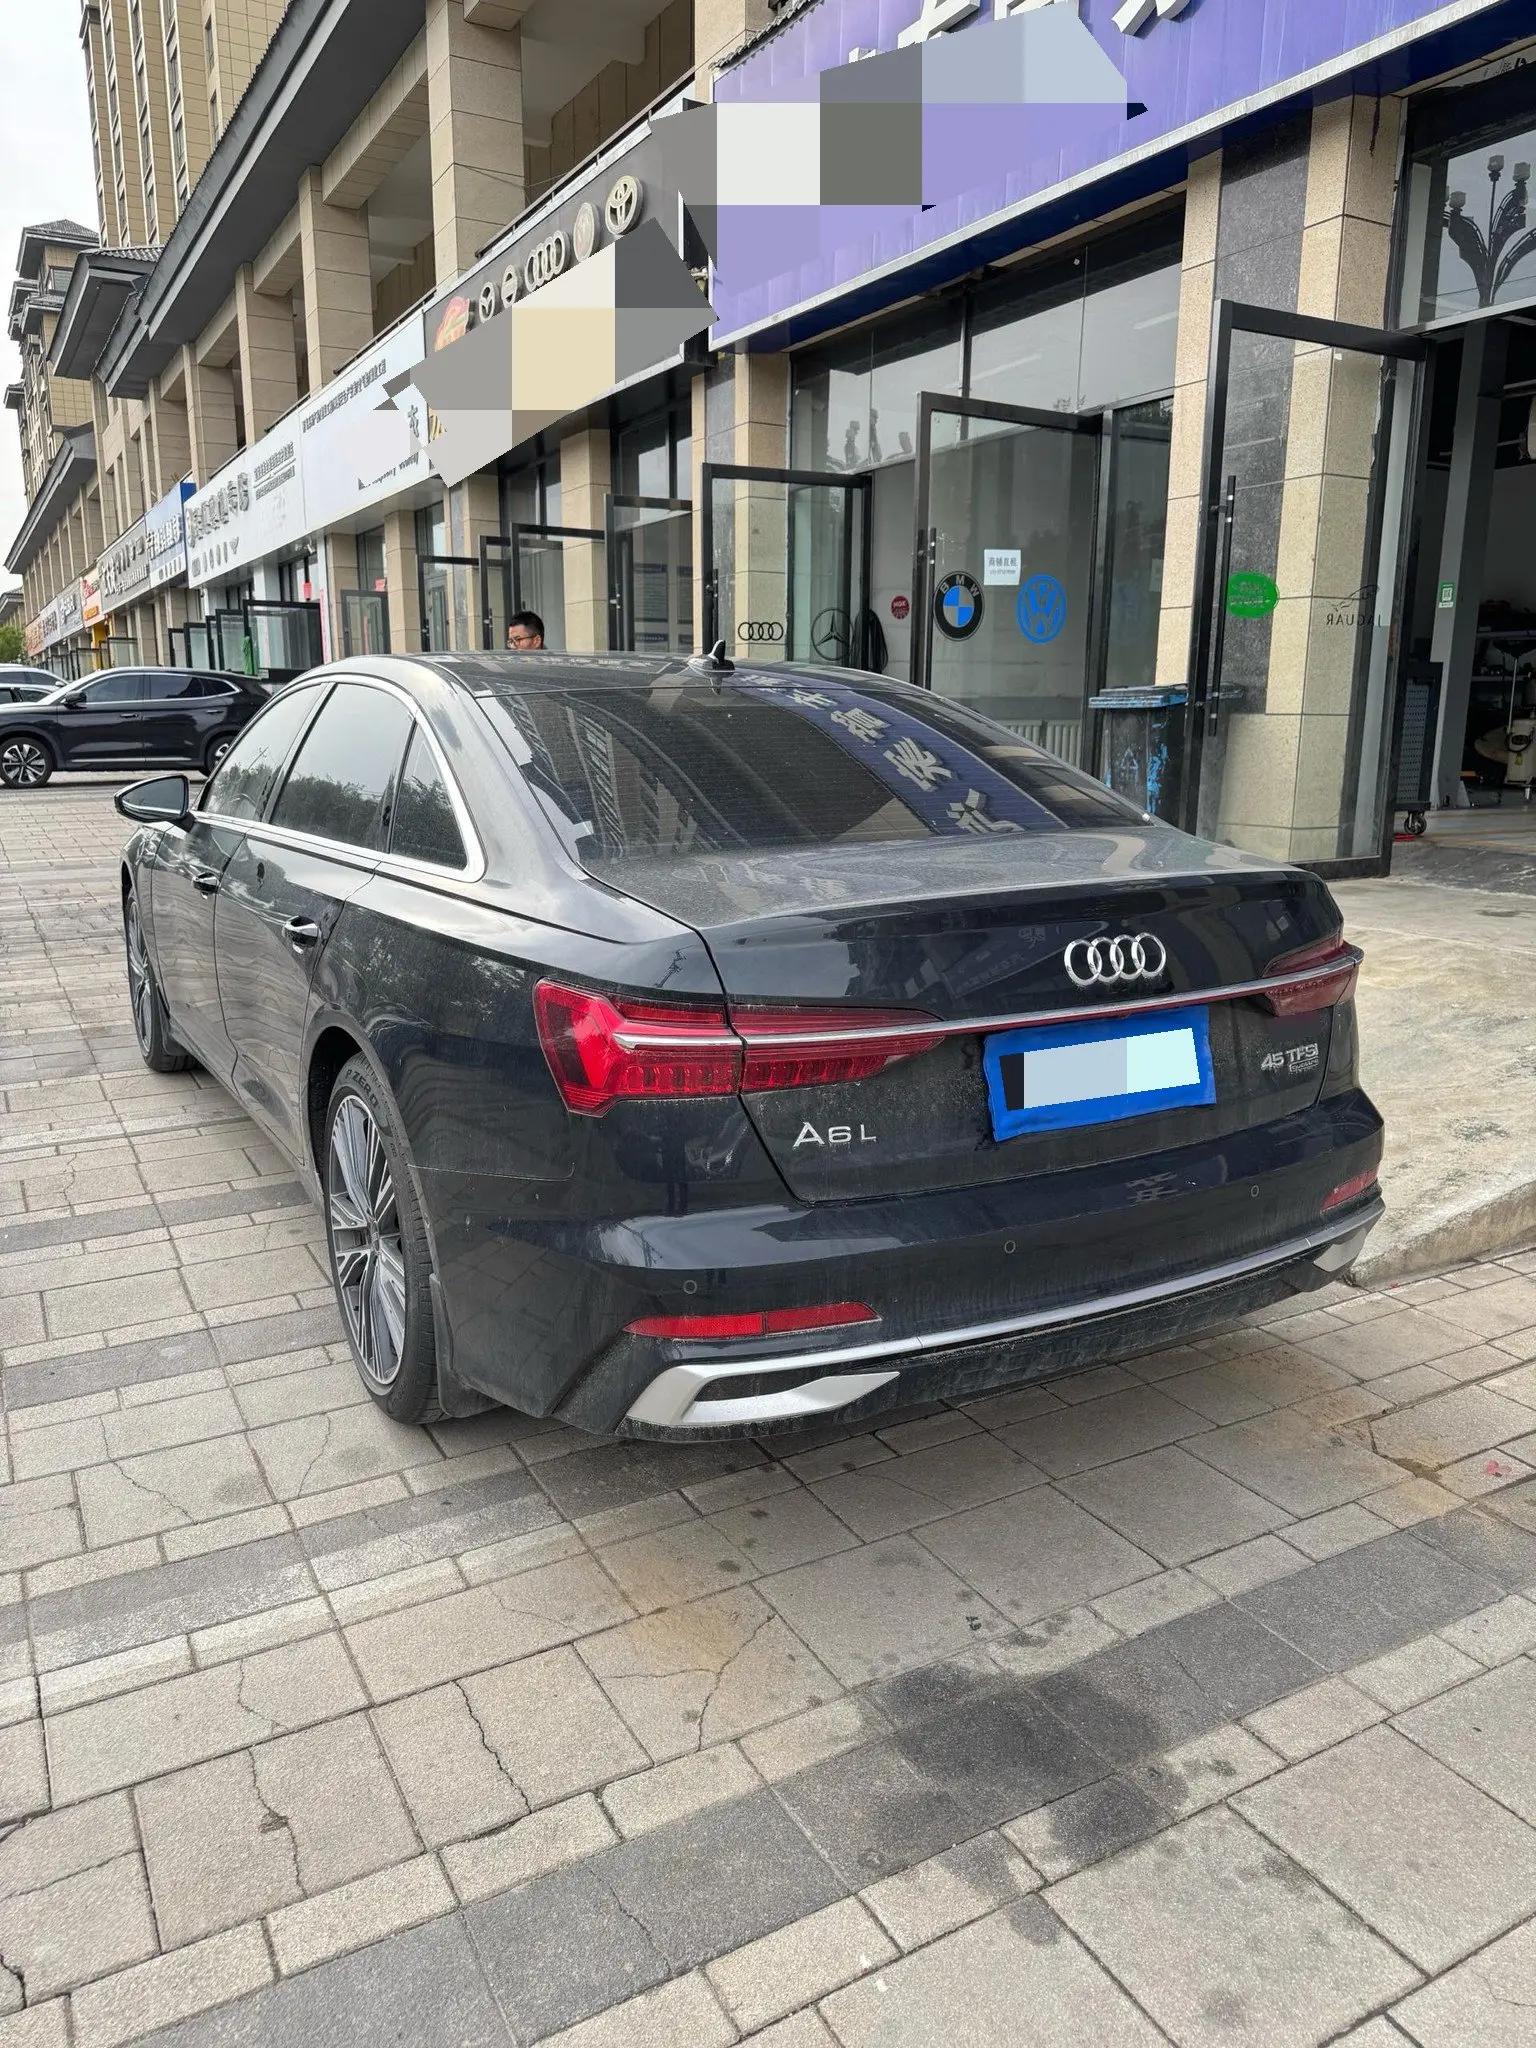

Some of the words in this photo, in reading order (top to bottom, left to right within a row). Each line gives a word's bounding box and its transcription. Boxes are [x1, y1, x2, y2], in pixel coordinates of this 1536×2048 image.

[939, 574, 981, 598] BMW
[1260, 1051, 1285, 1070] 45
[1286, 1044, 1318, 1062] TFSI
